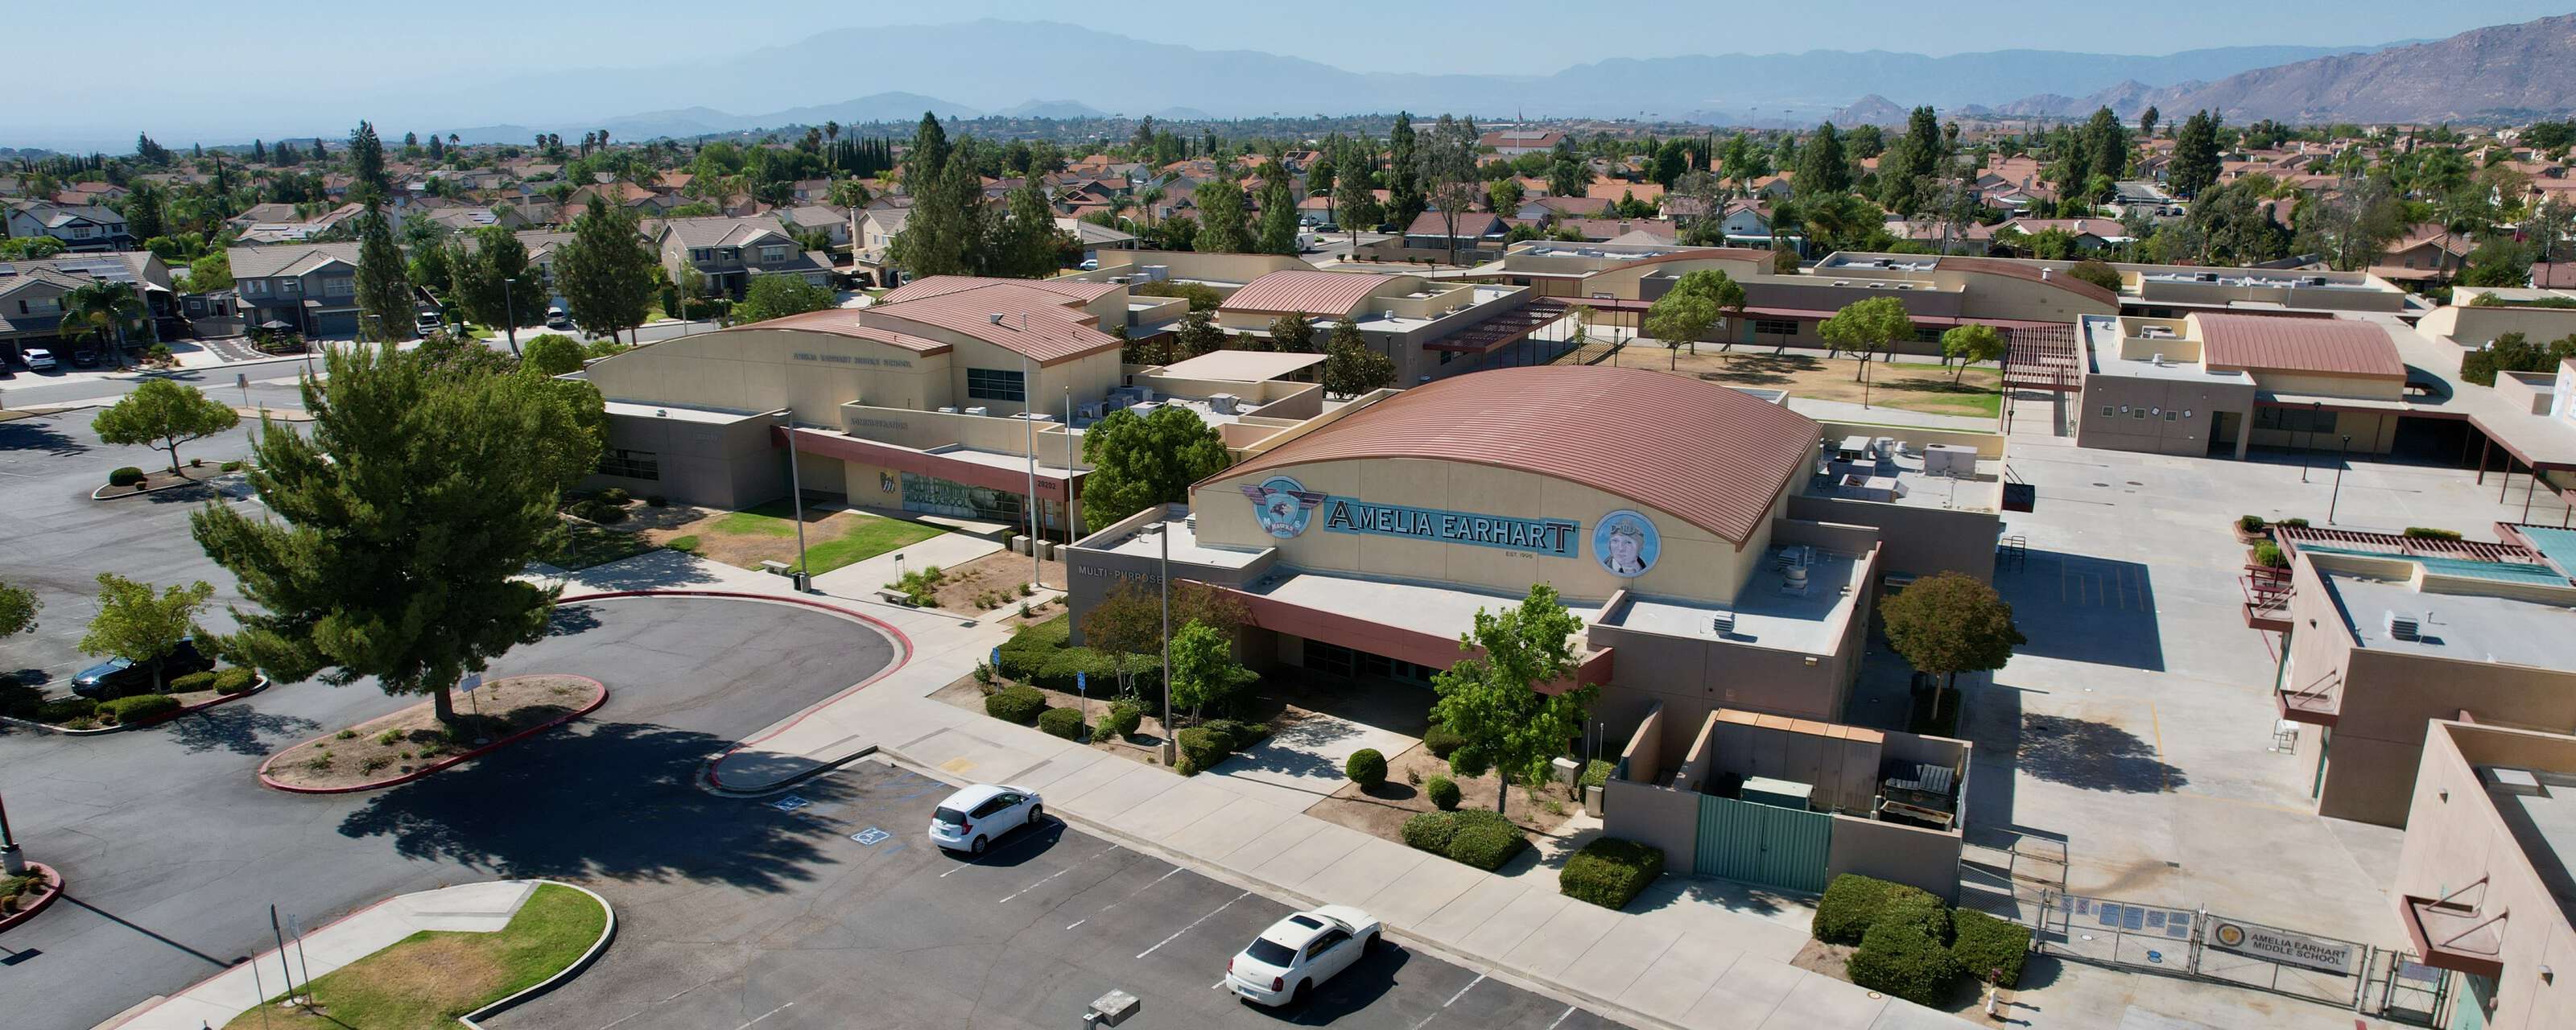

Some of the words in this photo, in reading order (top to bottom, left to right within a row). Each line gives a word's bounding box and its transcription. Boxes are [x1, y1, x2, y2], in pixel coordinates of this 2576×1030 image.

[883, 359, 913, 368] SCHOOL
[1038, 480, 1056, 489] 20202
[933, 492, 969, 509] SCHOOL
[1327, 500, 1434, 537] AMELIA
[1442, 513, 1575, 554] EARHART
[1078, 565, 1108, 577] MULTI
[1114, 570, 1162, 584] PURPOSE
[2251, 933, 2292, 947] AMELIA
[2294, 940, 2347, 958] EARHART
[2253, 941, 2293, 955] MIDDLE
[2296, 950, 2342, 965] SCHOOL
